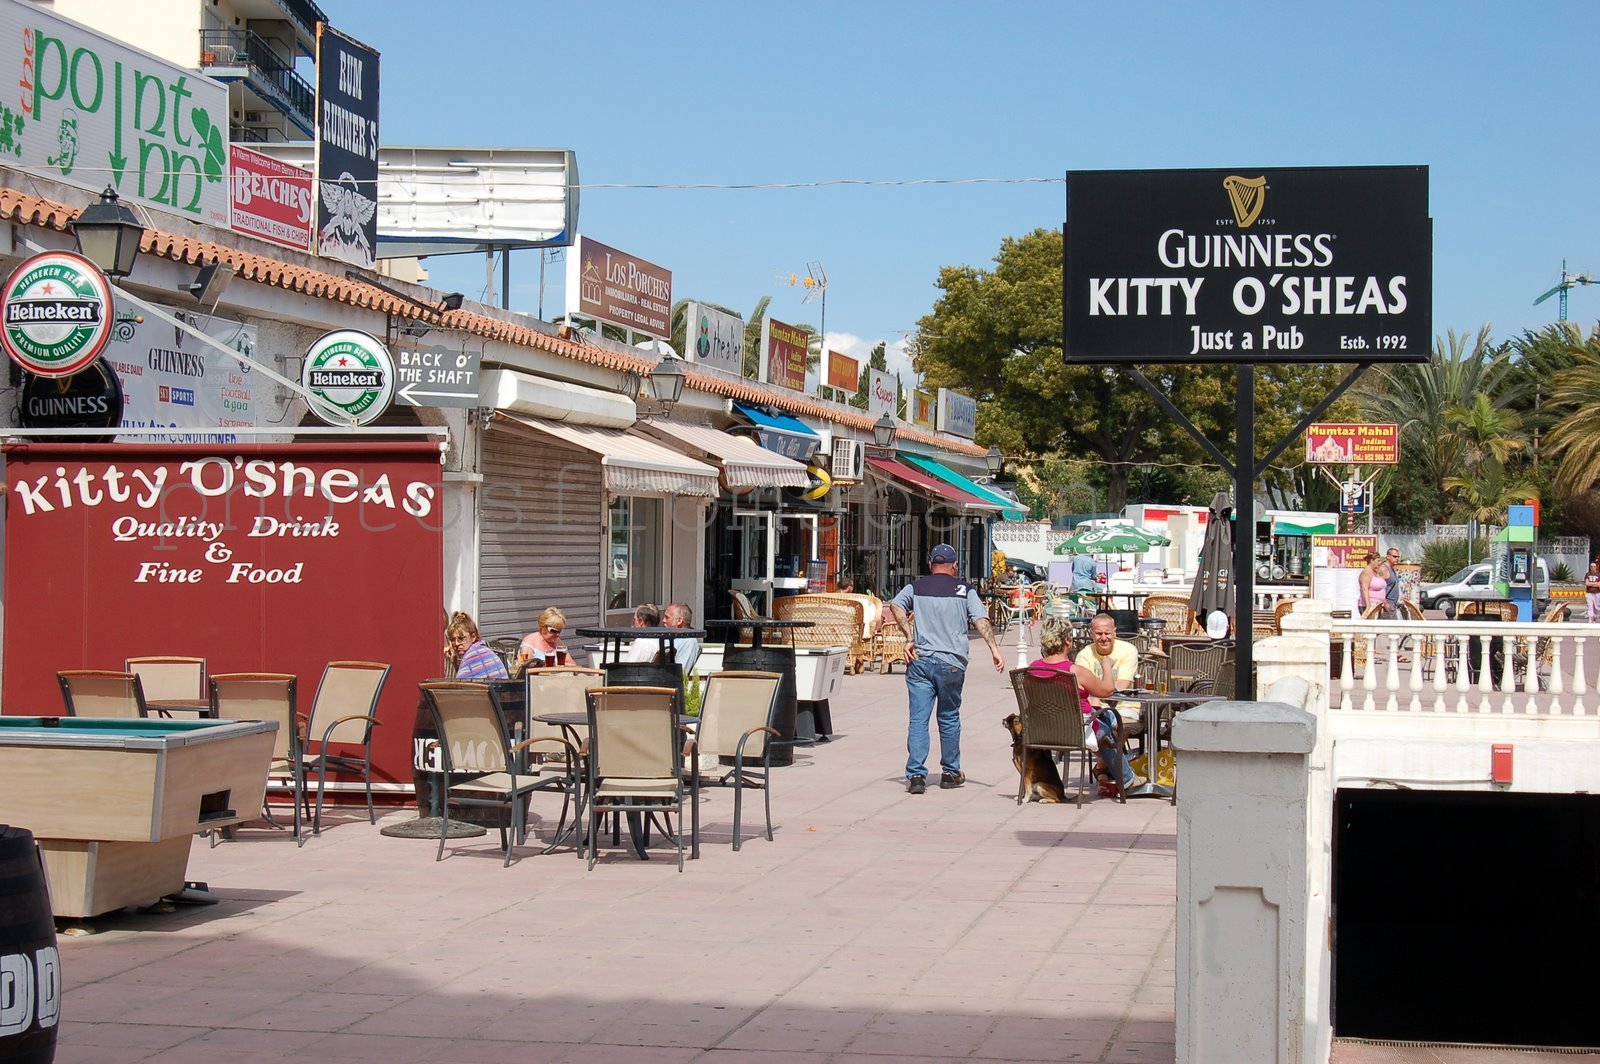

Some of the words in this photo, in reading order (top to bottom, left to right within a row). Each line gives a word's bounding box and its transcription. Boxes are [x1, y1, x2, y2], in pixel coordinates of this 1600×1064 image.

[339, 49, 363, 101] RUM
[250, 153, 271, 169] Welcome
[233, 212, 271, 233] TRADITIONAL
[272, 224, 285, 237] FISH
[286, 229, 291, 238] &
[291, 230, 308, 244] CHIPS
[19, 267, 61, 290] HEINEKEN
[640, 298, 653, 310] REAL
[652, 302, 669, 315] ESTATE
[1089, 278, 1205, 316] KITTY
[9, 302, 93, 321] Heineken
[608, 304, 634, 321] PROPERTY
[634, 313, 649, 325] LEGAL
[15, 332, 51, 357] PREMIUM
[52, 331, 86, 357] QUALITY
[1190, 326, 1234, 355] Just
[1241, 331, 1253, 351] a
[1262, 325, 1304, 351] Pub
[1340, 335, 1370, 350] Estb.
[1375, 335, 1407, 350] 1992
[148, 347, 205, 378] GUINNESS
[320, 344, 353, 362] HEINEKEN
[353, 347, 370, 363] BEER
[401, 352, 440, 367] BACK
[313, 372, 378, 386] Heineken
[399, 368, 422, 383] THE
[427, 370, 473, 385] SHAFT
[28, 396, 108, 416] GUINNESS
[172, 391, 194, 405] SPORTS
[347, 393, 373, 413] QUALITY
[1309, 426, 1355, 435] Mumtaz
[1357, 426, 1394, 435] Mahal
[112, 516, 224, 542] Quality
[248, 516, 340, 538] Drink
[1314, 537, 1348, 547] Mumtaz
[1348, 537, 1374, 547] Mahal
[205, 542, 232, 563] &
[135, 563, 202, 583] Fine
[226, 563, 304, 583] Food
